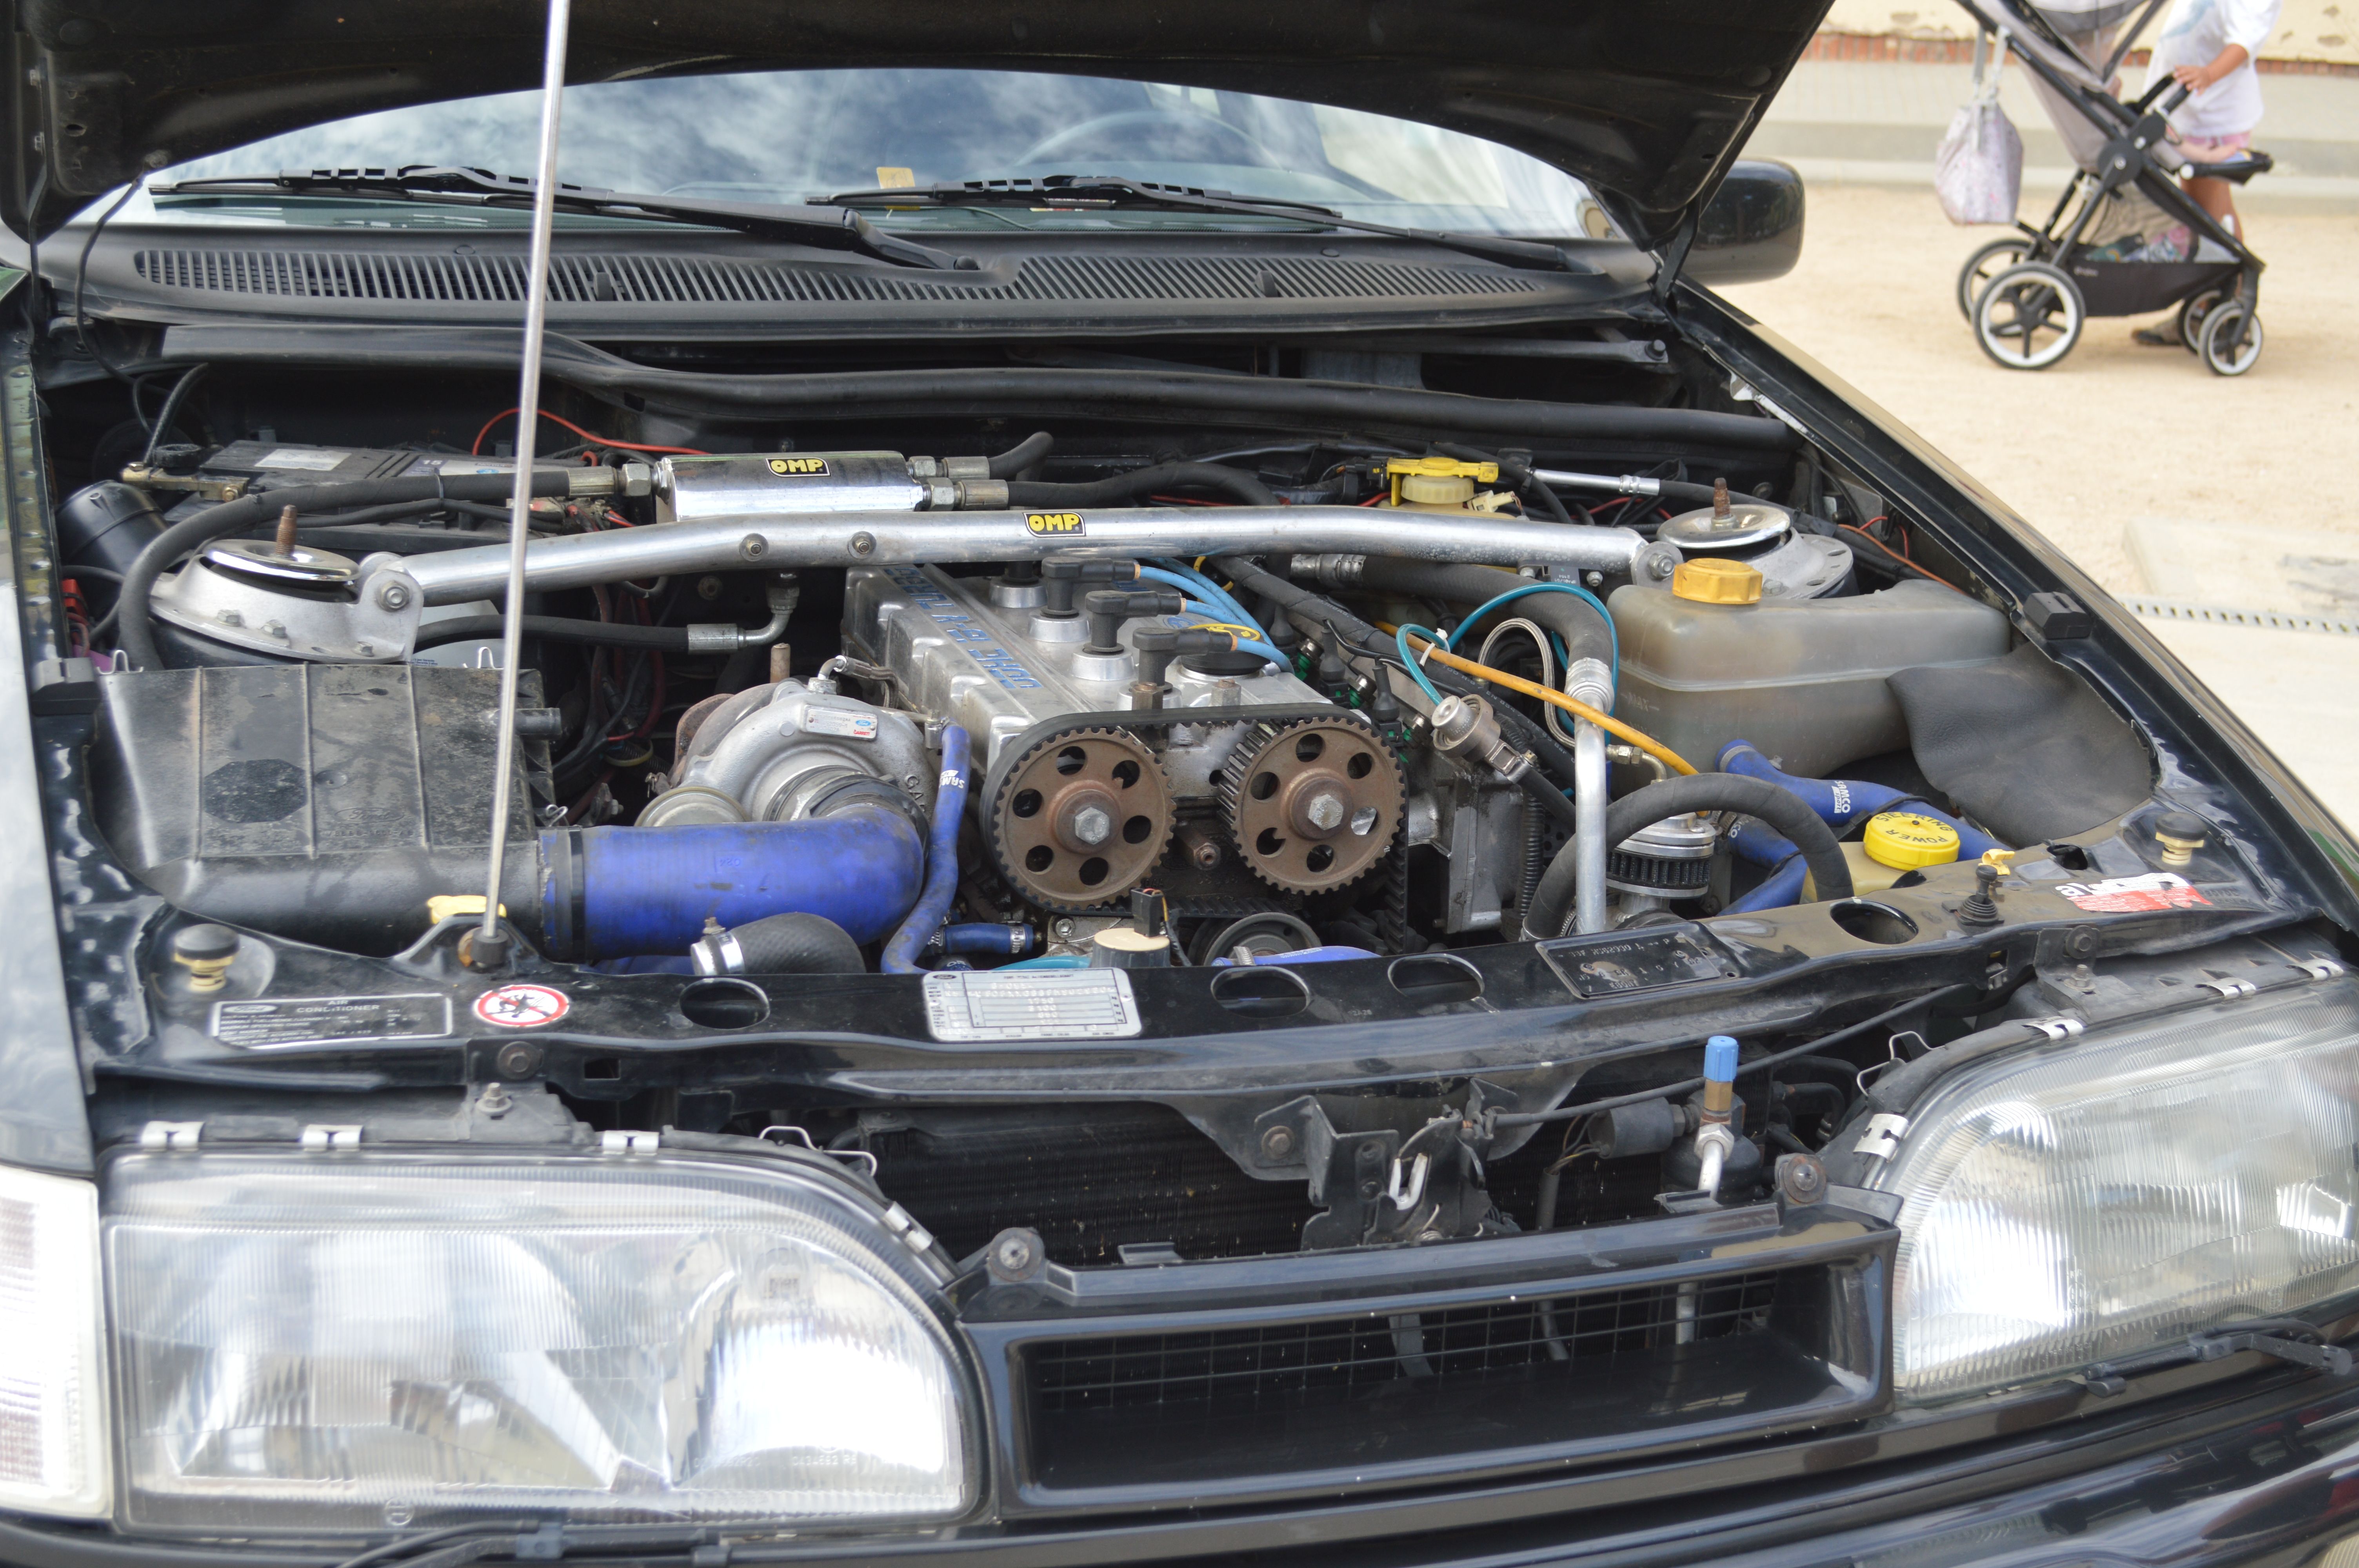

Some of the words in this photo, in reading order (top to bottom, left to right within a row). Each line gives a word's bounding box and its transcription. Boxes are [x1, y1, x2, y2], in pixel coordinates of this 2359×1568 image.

[770, 459, 823, 473] OMP
[1028, 512, 1080, 531] OMP
[967, 648, 1044, 689] DOHC
[1485, 690, 1498, 701] EN
[1834, 780, 1851, 813] SAMCO
[1875, 811, 1954, 832] STEERING
[1885, 829, 1949, 844] POWER
